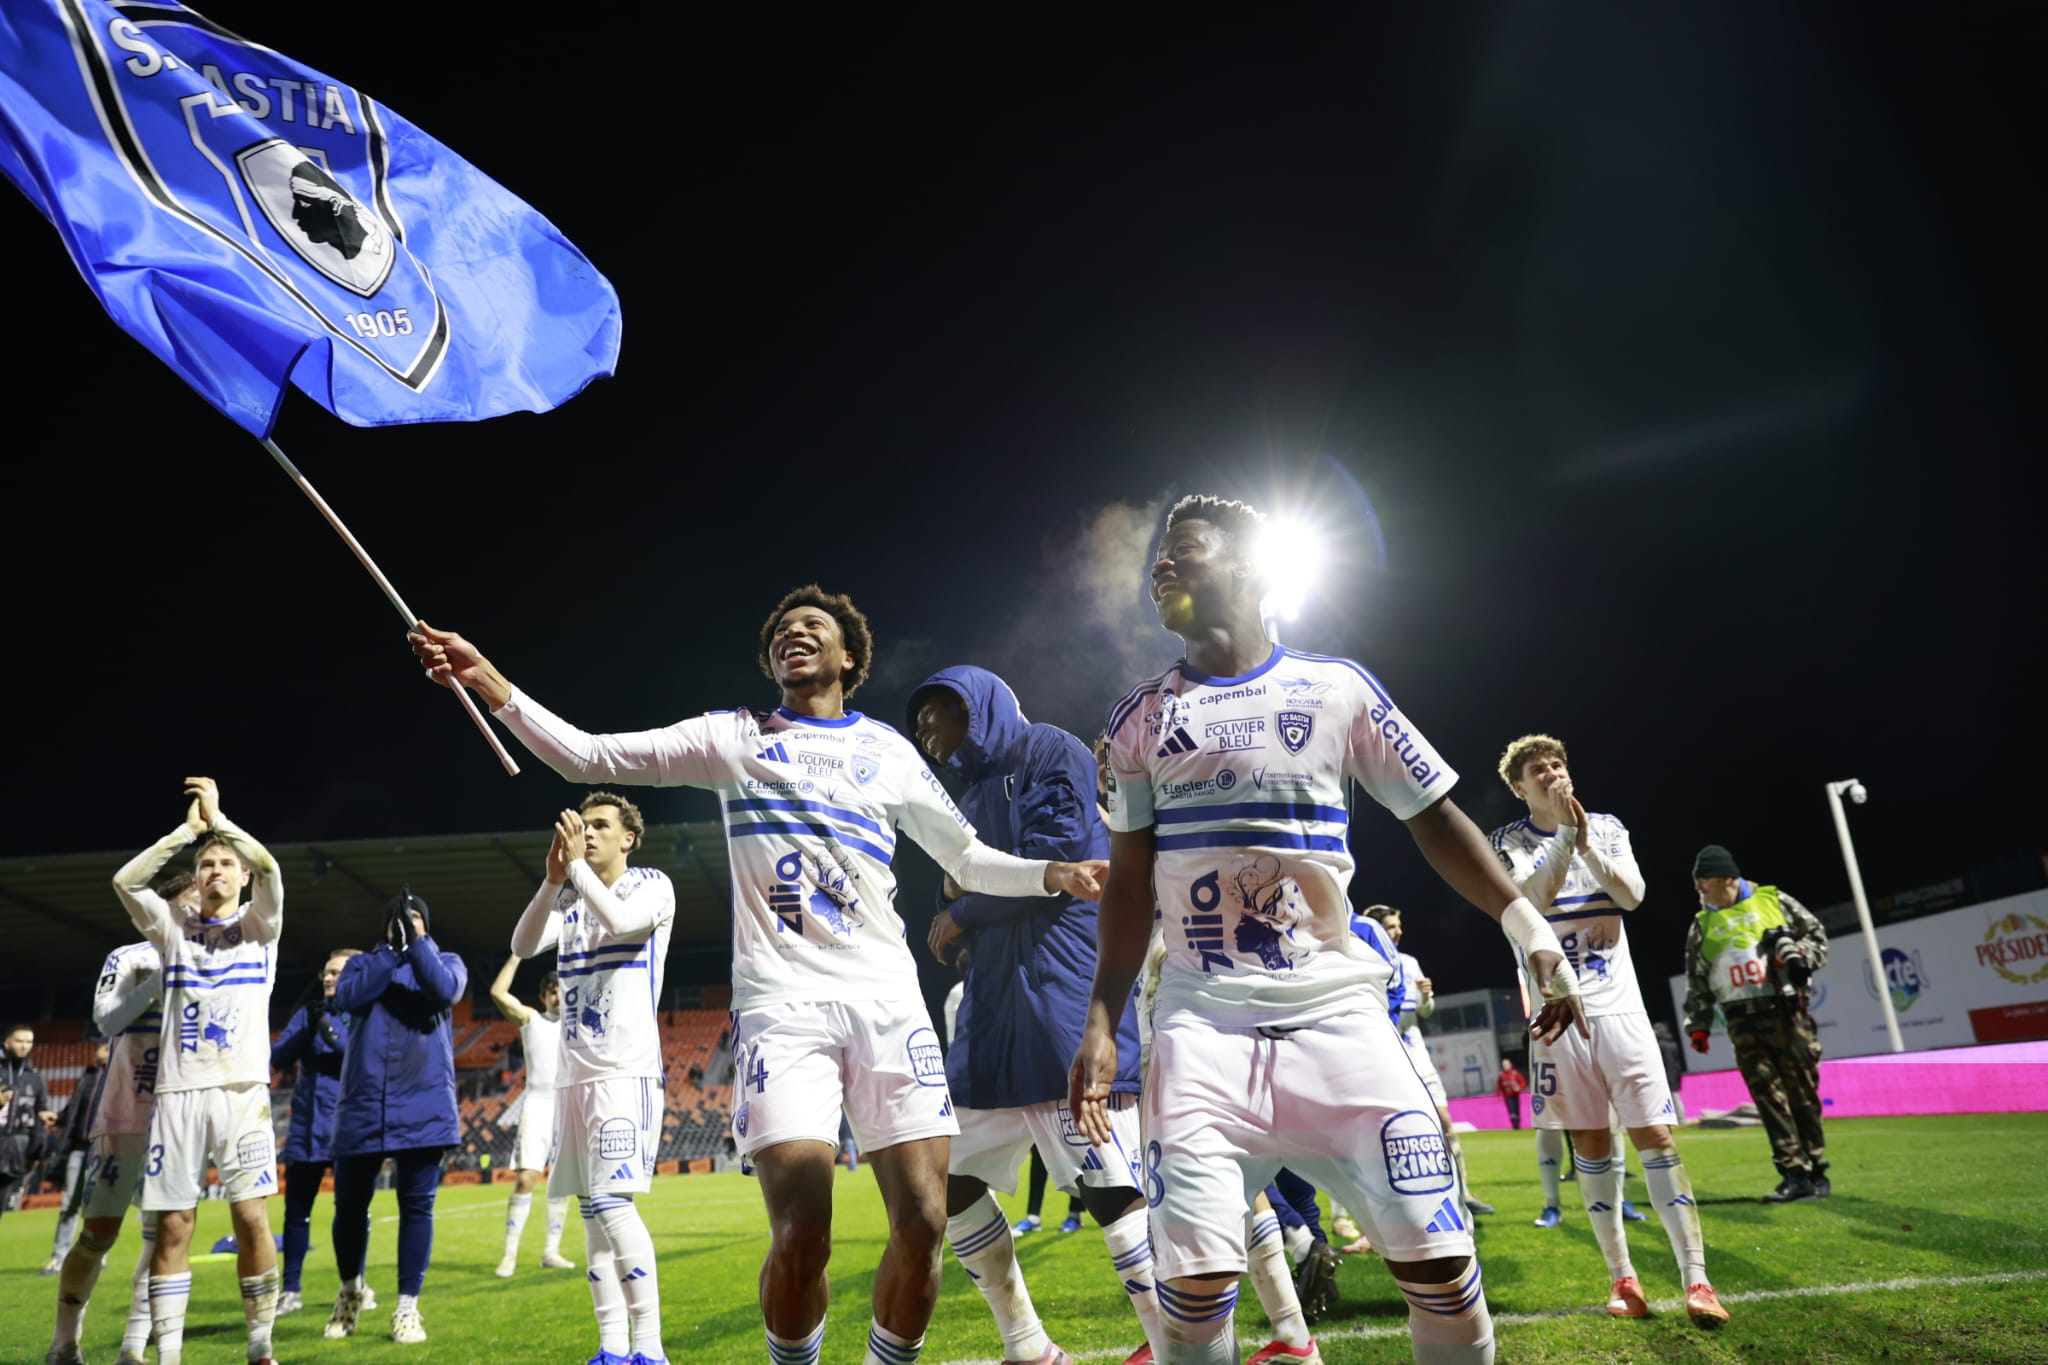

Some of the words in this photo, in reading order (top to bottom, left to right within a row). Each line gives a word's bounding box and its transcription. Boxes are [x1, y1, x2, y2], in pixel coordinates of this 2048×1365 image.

[202, 64, 357, 135] ASTIA
[344, 308, 414, 338] 1905
[1199, 684, 1266, 705] capembal
[794, 733, 845, 744] capembal
[1205, 720, 1265, 738] L'OLIVIER
[1219, 734, 1252, 749] BLEU
[1370, 703, 1441, 789] actual
[798, 753, 844, 769] L'OLIVIER
[807, 765, 833, 776] BLEU
[747, 780, 797, 790] E.Leclerc
[920, 769, 970, 828] actual
[1162, 779, 1215, 795] E.Leclerc
[769, 850, 803, 936] zilia
[1182, 869, 1234, 973] zilia
[1975, 933, 2048, 968] PRÉSIDE
[1729, 960, 1765, 988] 09
[564, 985, 579, 1040] zilia
[180, 1001, 200, 1053] zilia
[737, 1044, 769, 1099] 14
[914, 1057, 945, 1076] KIN
[1532, 1062, 1557, 1097] 15
[600, 1140, 635, 1152] KING
[601, 1130, 635, 1140] BURGER
[1385, 1136, 1445, 1157] BURGER
[88, 1155, 120, 1187] 24
[1388, 1152, 1451, 1180] KING
